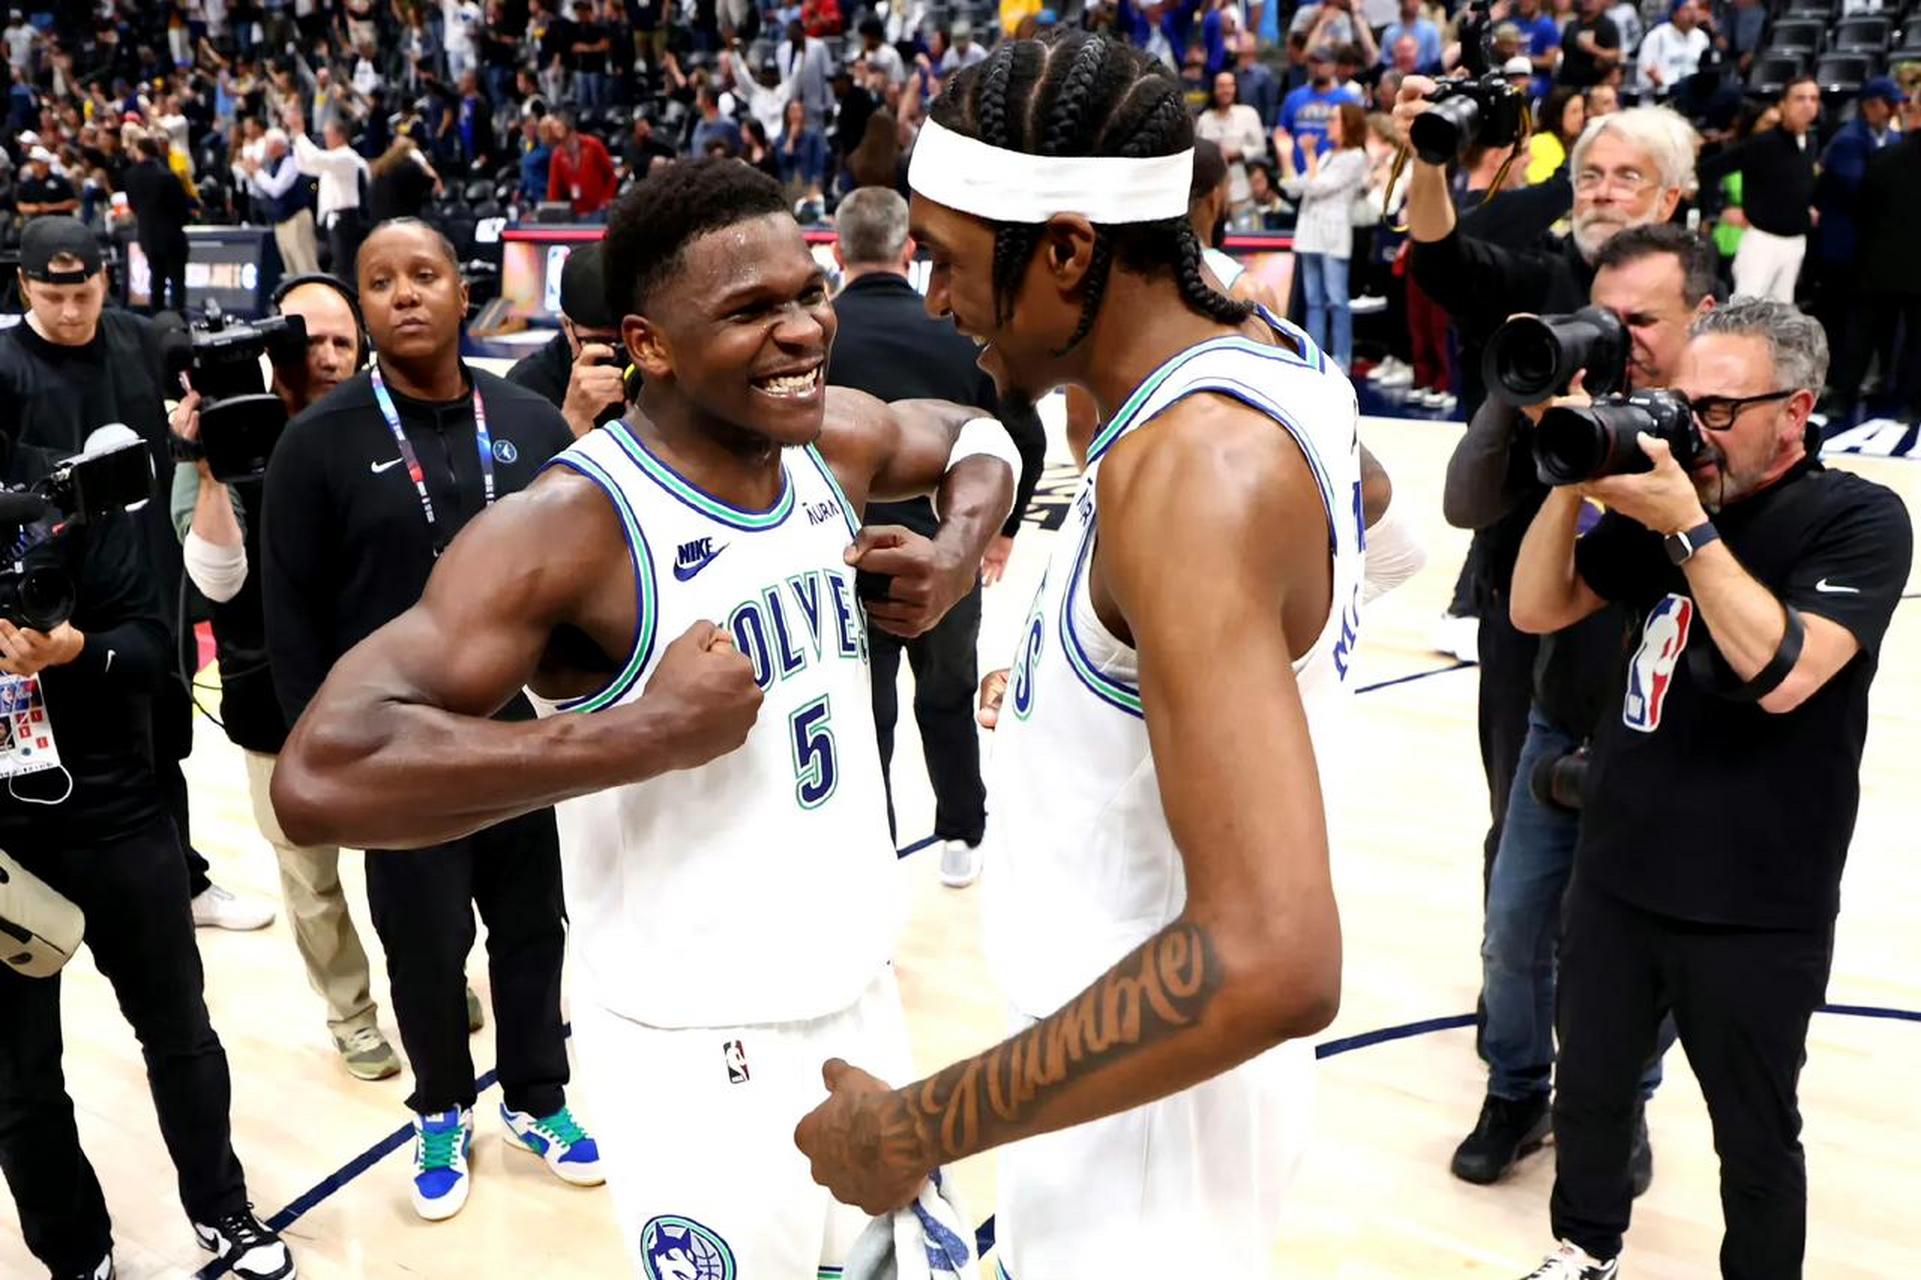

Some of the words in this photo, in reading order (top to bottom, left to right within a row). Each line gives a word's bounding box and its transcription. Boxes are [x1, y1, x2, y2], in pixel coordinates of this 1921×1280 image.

[677, 536, 713, 565] NIKE
[727, 568, 869, 693] OLVE
[789, 693, 838, 809] 5
